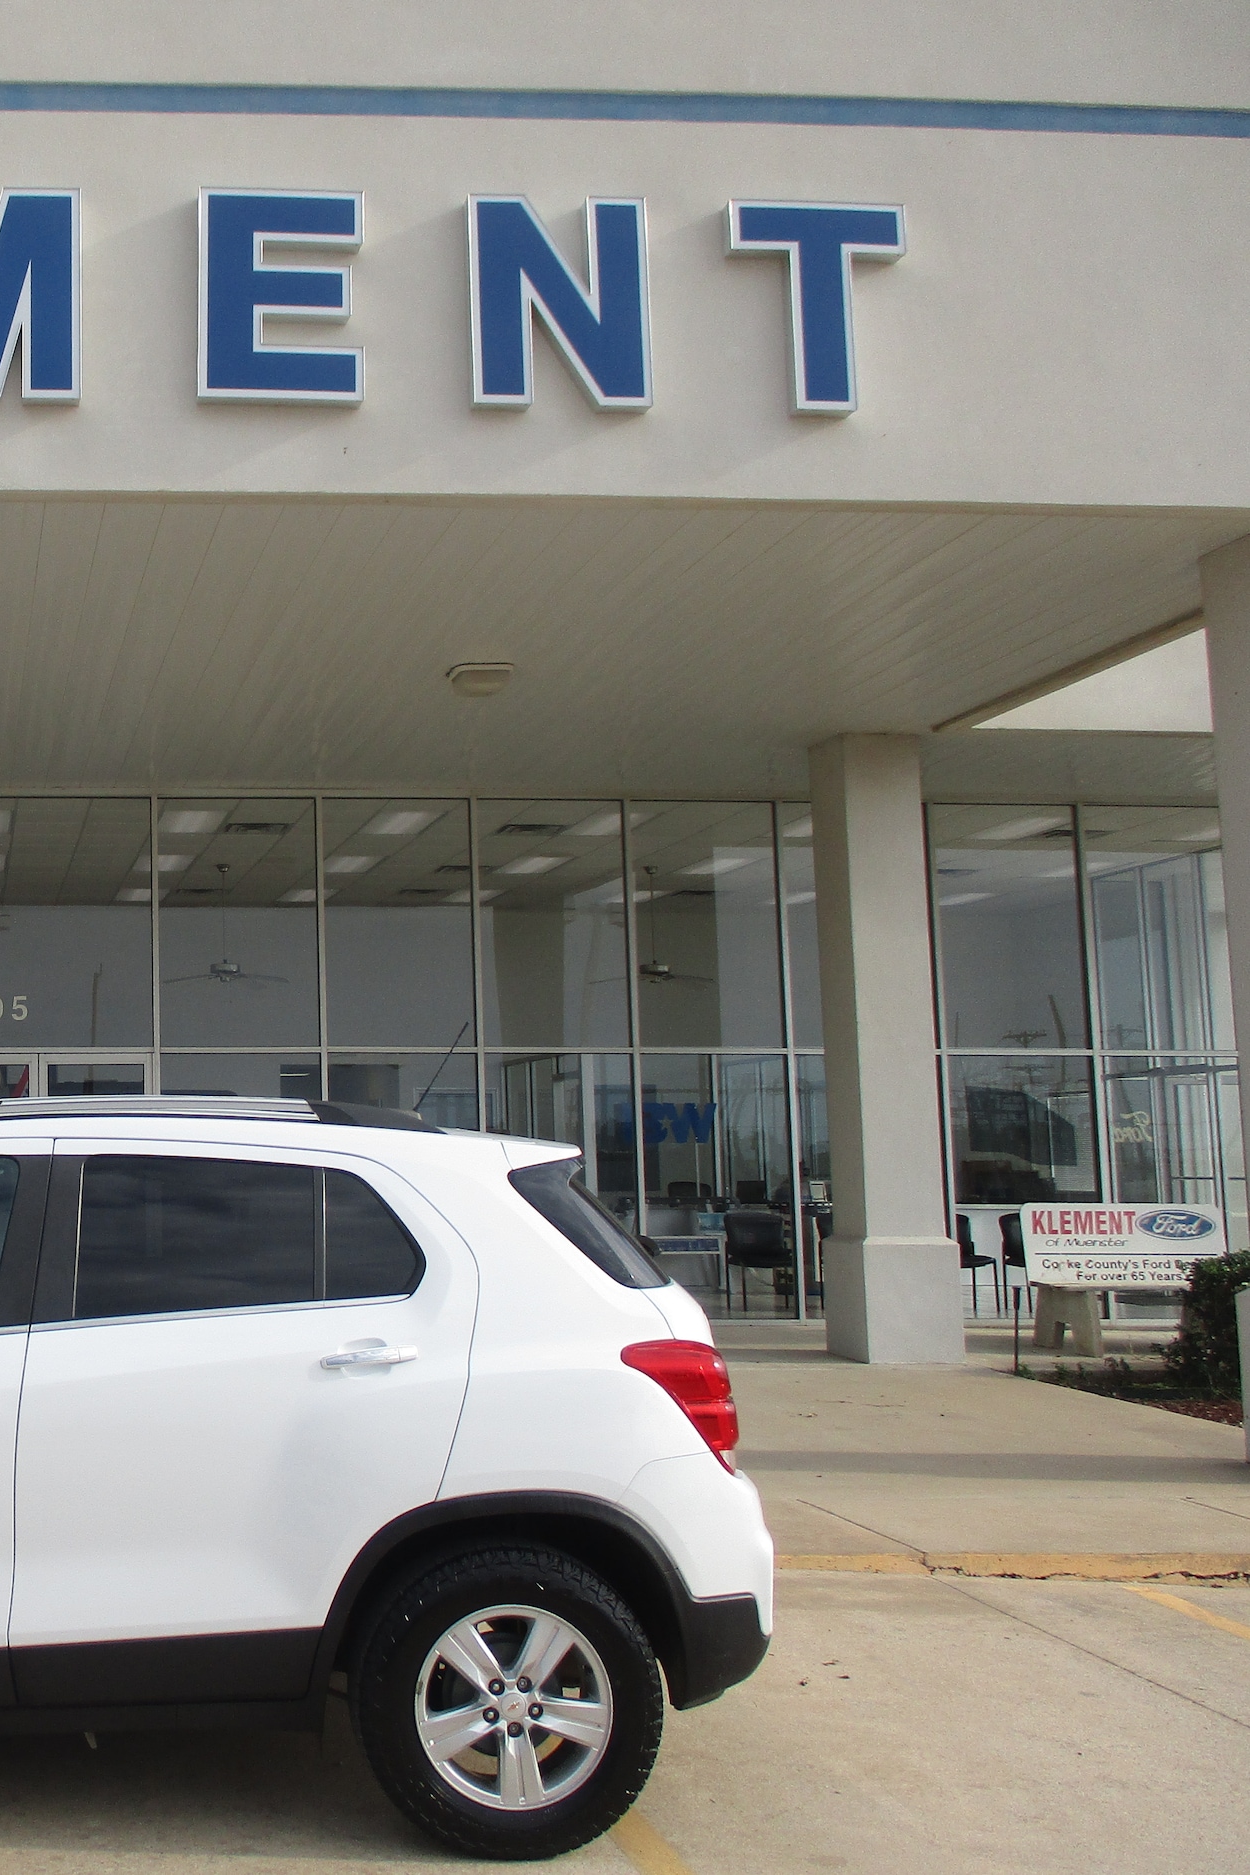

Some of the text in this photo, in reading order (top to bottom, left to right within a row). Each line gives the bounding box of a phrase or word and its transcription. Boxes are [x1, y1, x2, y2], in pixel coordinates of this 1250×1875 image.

[1031, 1210, 1136, 1235] KLEMENT
[1152, 1213, 1204, 1236] Ford
[1045, 1237, 1130, 1247] of Muenster
[1042, 1259, 1081, 1269] Coke
[1084, 1259, 1139, 1272] County's
[1142, 1259, 1171, 1269] Ford
[1076, 1270, 1097, 1281] For
[1100, 1272, 1128, 1281] over
[1130, 1270, 1146, 1281] 65
